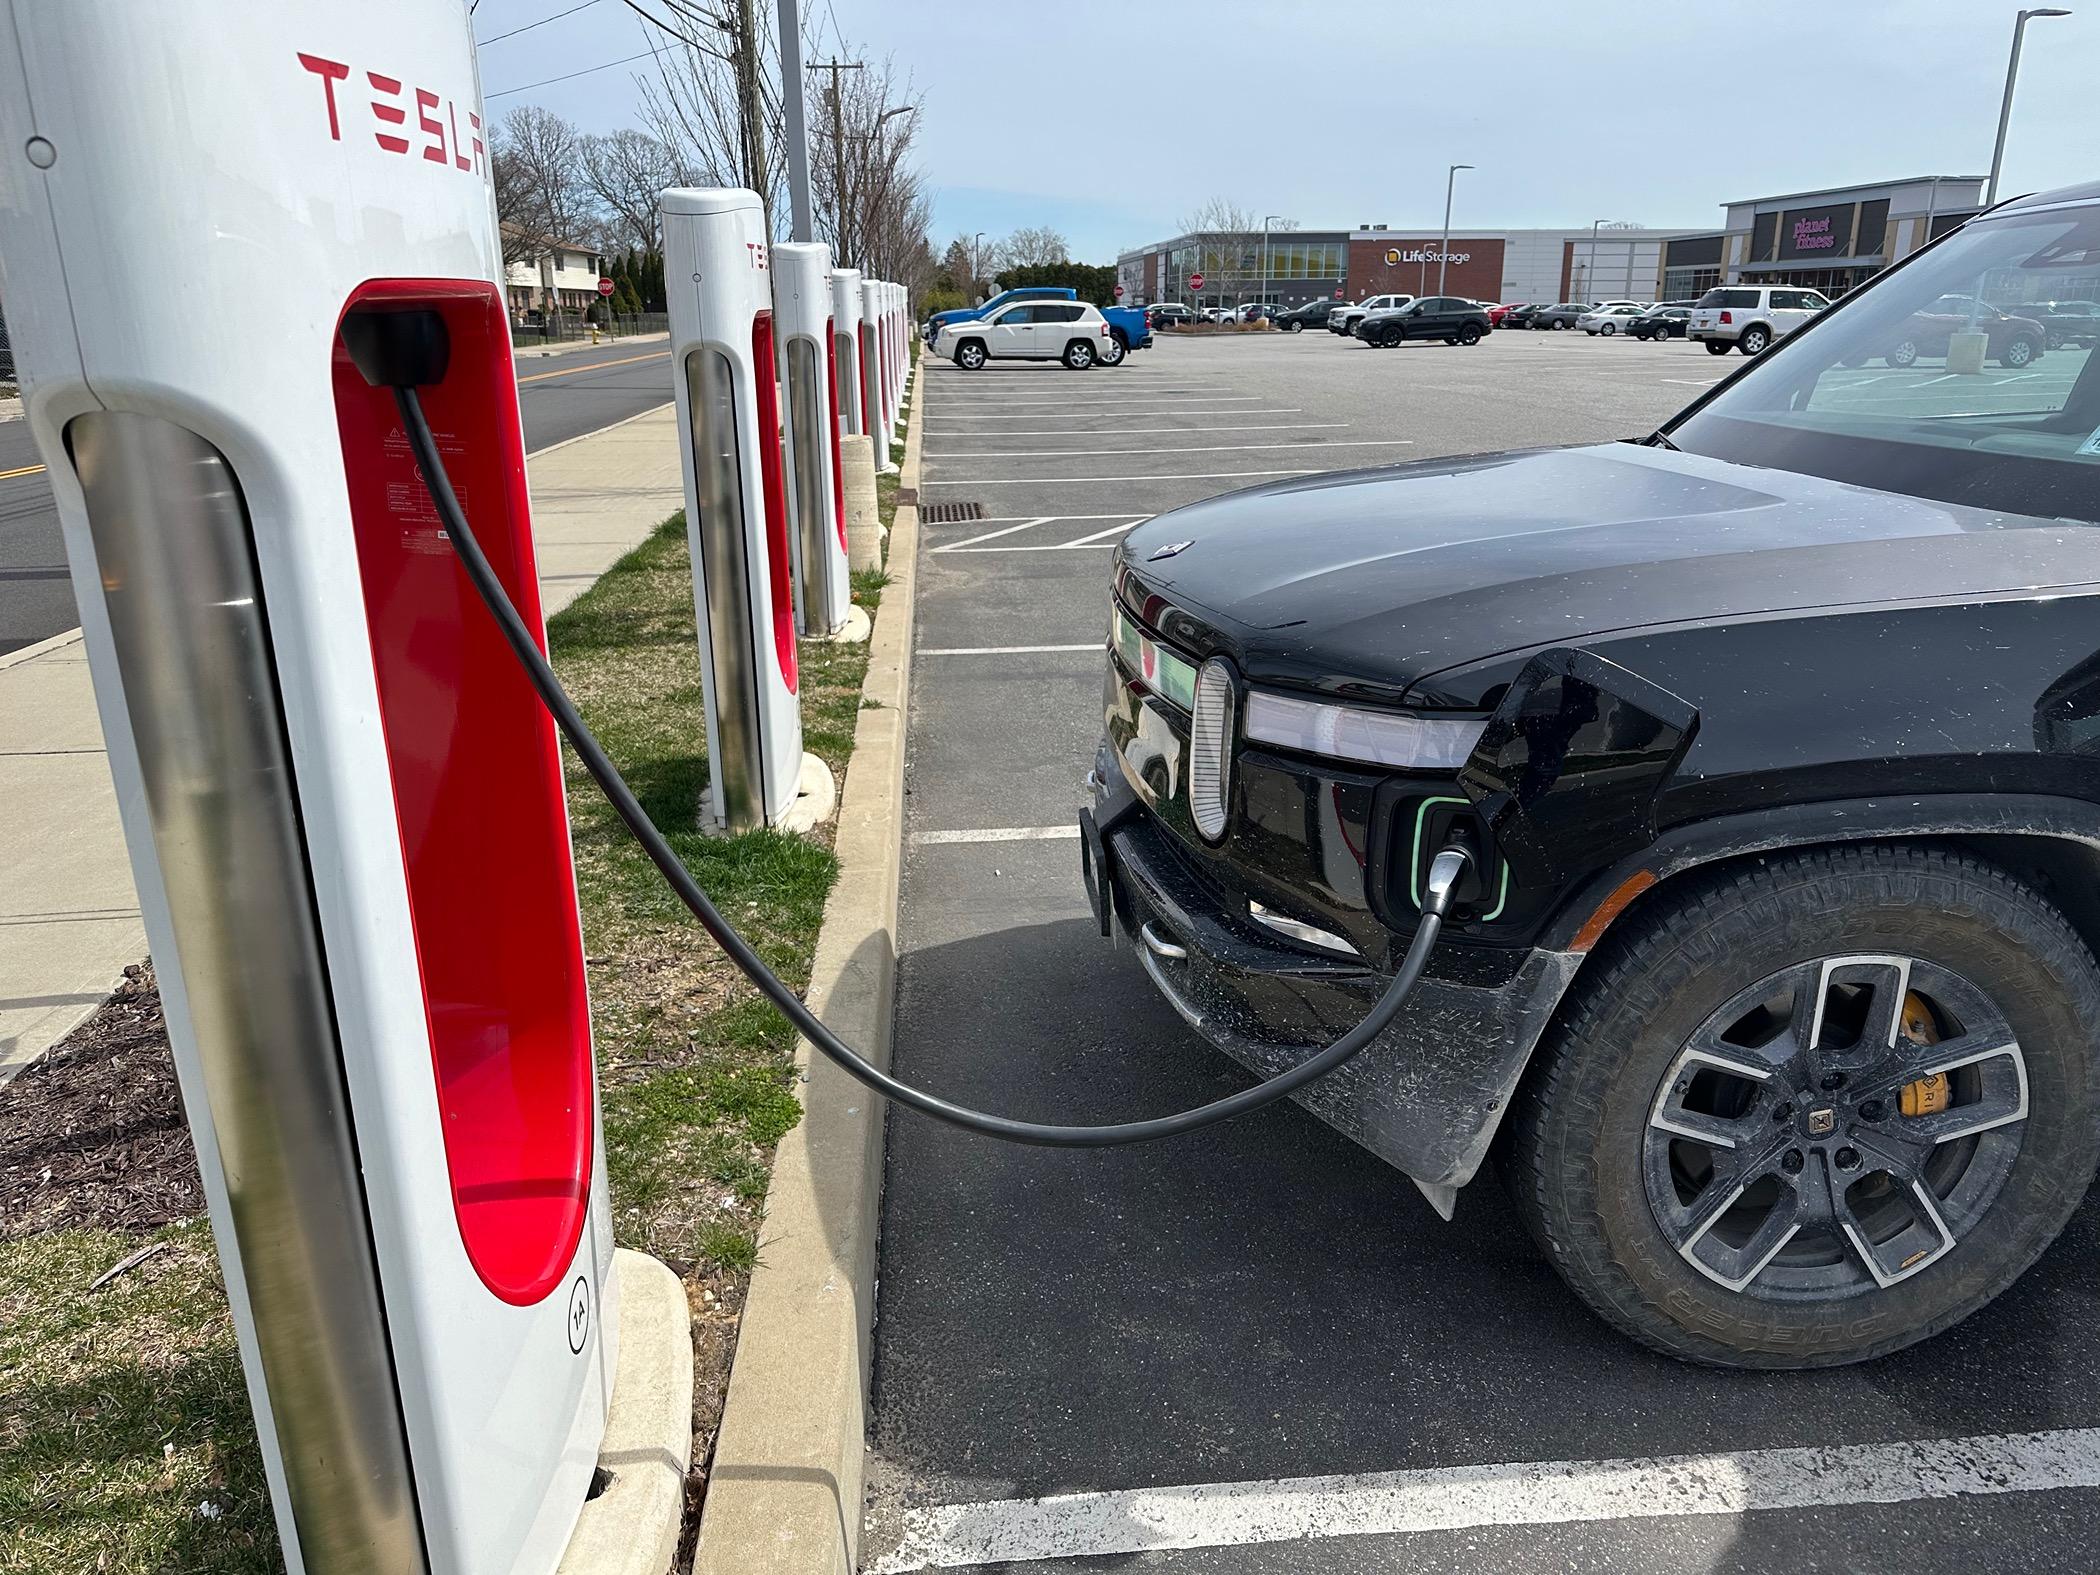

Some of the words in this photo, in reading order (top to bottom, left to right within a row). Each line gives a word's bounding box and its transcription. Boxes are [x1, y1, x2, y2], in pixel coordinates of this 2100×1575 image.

[296, 51, 488, 180] TESLA
[599, 283, 613, 291] STOP
[573, 1299, 586, 1332] 1A
